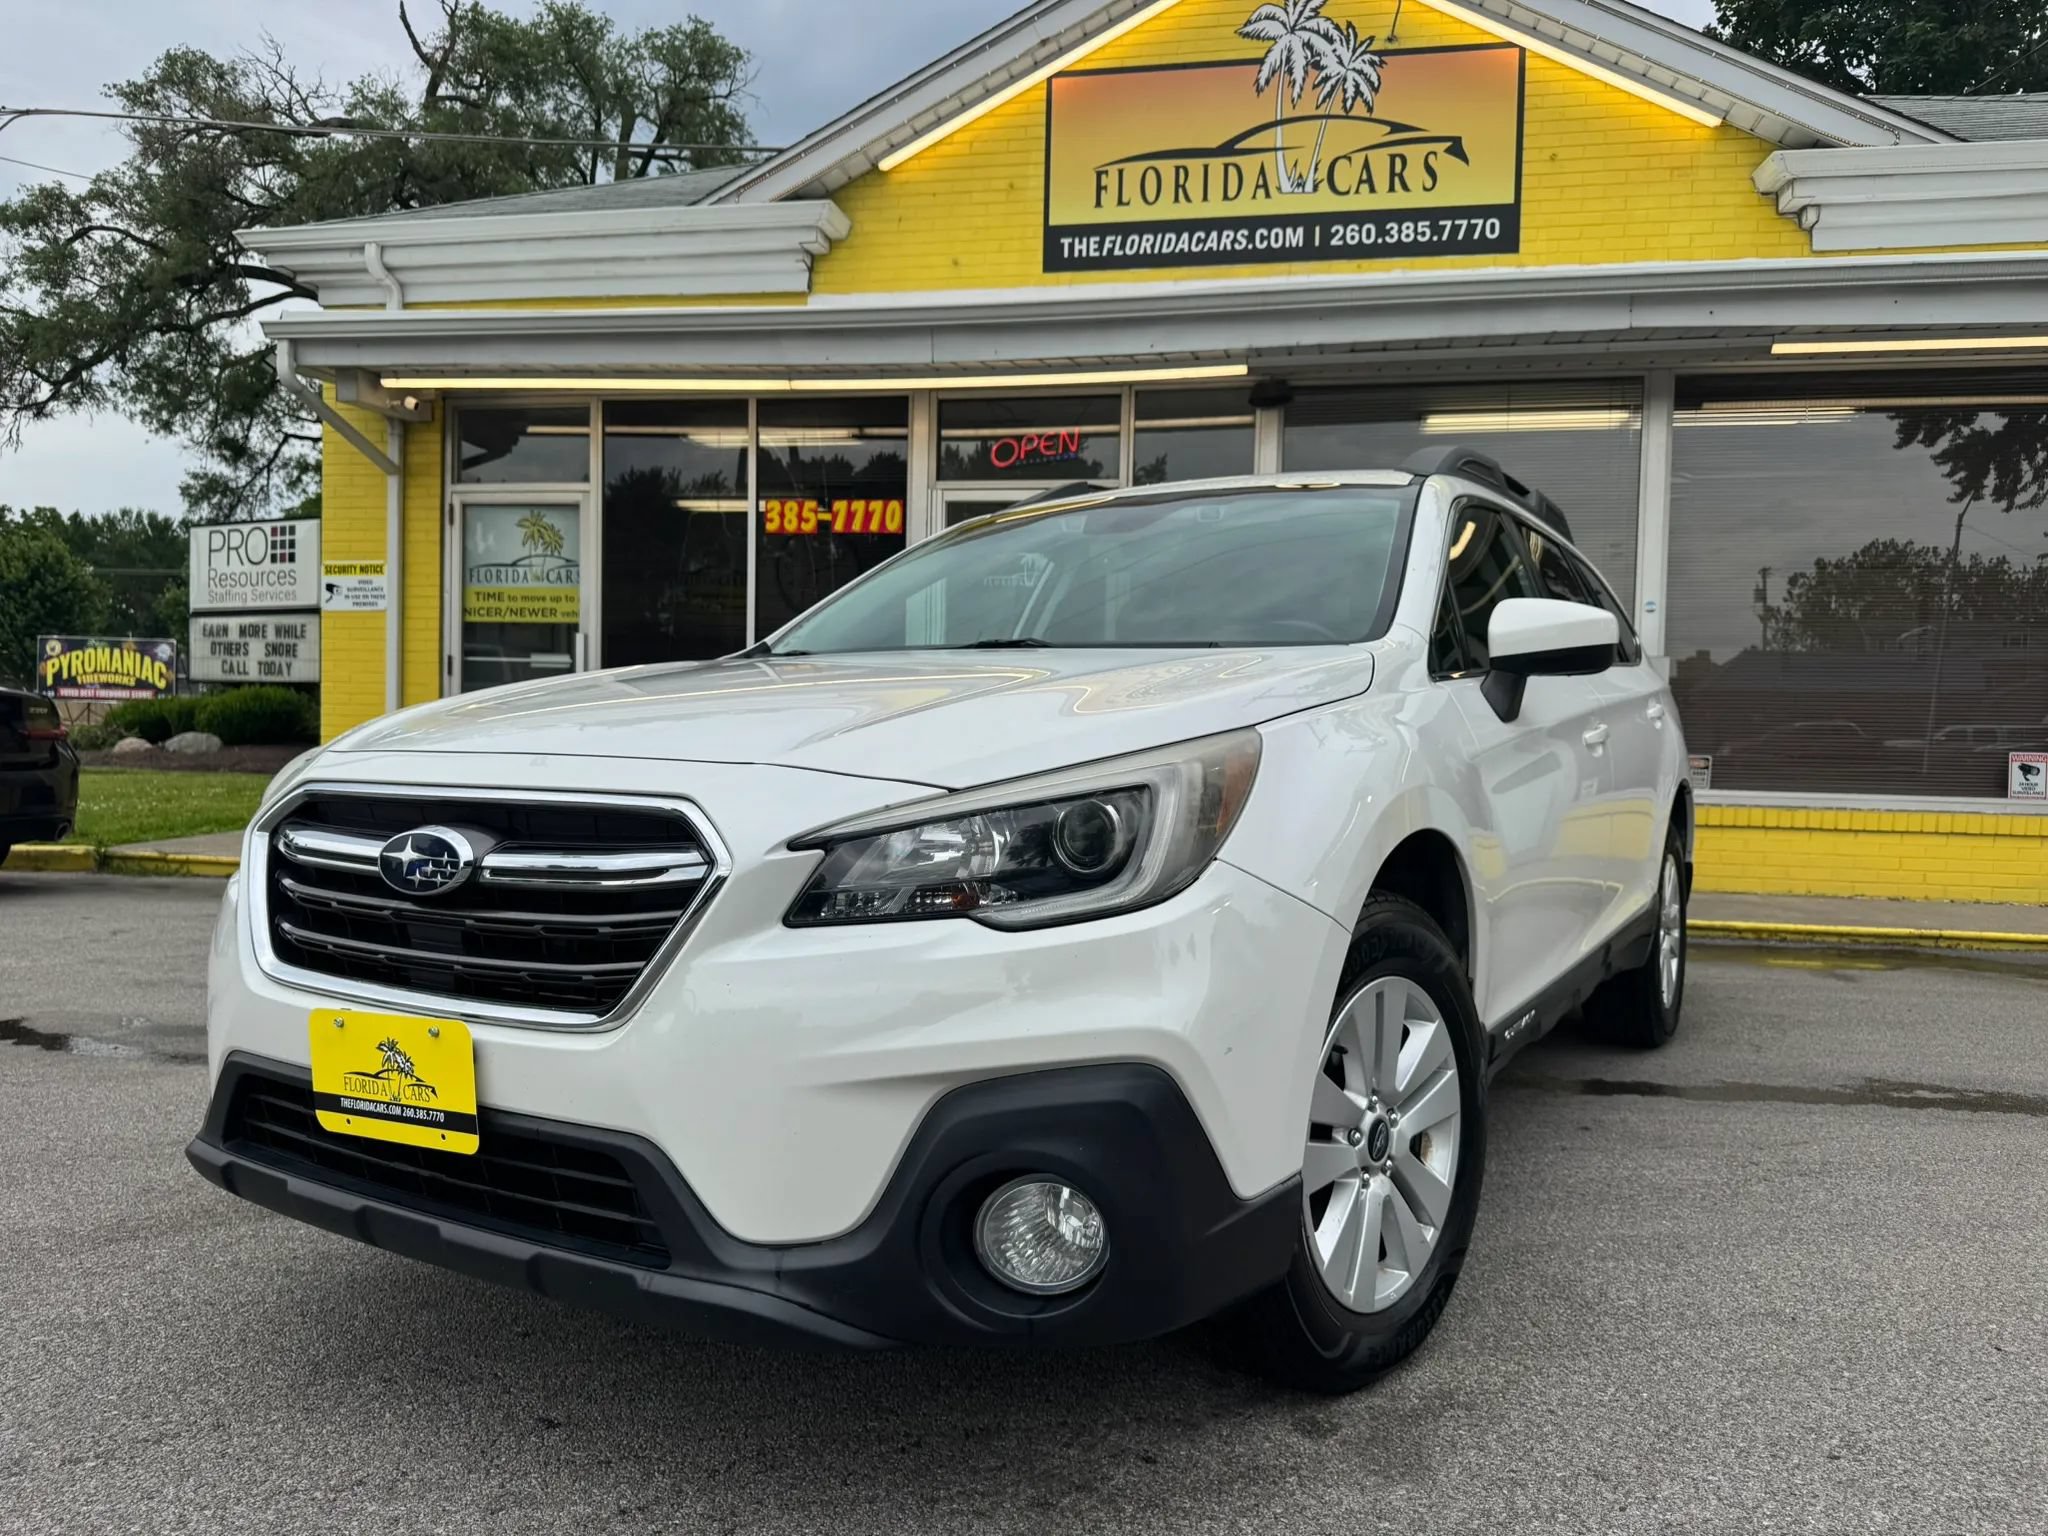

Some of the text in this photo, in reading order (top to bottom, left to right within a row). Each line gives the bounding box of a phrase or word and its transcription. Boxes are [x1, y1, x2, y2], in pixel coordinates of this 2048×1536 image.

[1093, 151, 1439, 208] FLORIDA CARS
[1061, 226, 1304, 258] THEFLORIDACARS.COM
[1331, 218, 1500, 246] 260.385.7770
[991, 427, 1080, 468] OPEN
[765, 499, 902, 533] 385-7770
[208, 526, 268, 566] PRO
[208, 568, 297, 589] Resources
[324, 564, 385, 576] SECURITY NOTICE
[469, 568, 529, 584] FLORIDA
[208, 588, 297, 604] Staffing Services
[474, 591, 505, 603] TIME
[508, 594, 518, 603] to
[549, 595, 562, 604] up
[565, 594, 575, 603] to
[464, 607, 558, 619] NICER/NEWER
[202, 623, 307, 639] EARN MORE WHILE
[210, 641, 298, 658] OTHERS SNORE
[46, 646, 168, 690] PYROMANIAC
[221, 659, 292, 677] CALL TODAY
[76, 673, 136, 687] FIREWORKS
[343, 1075, 431, 1103] FLORIDA CARS
[340, 1097, 445, 1123] THEFLORIDACARS.COM 260.385.7770
